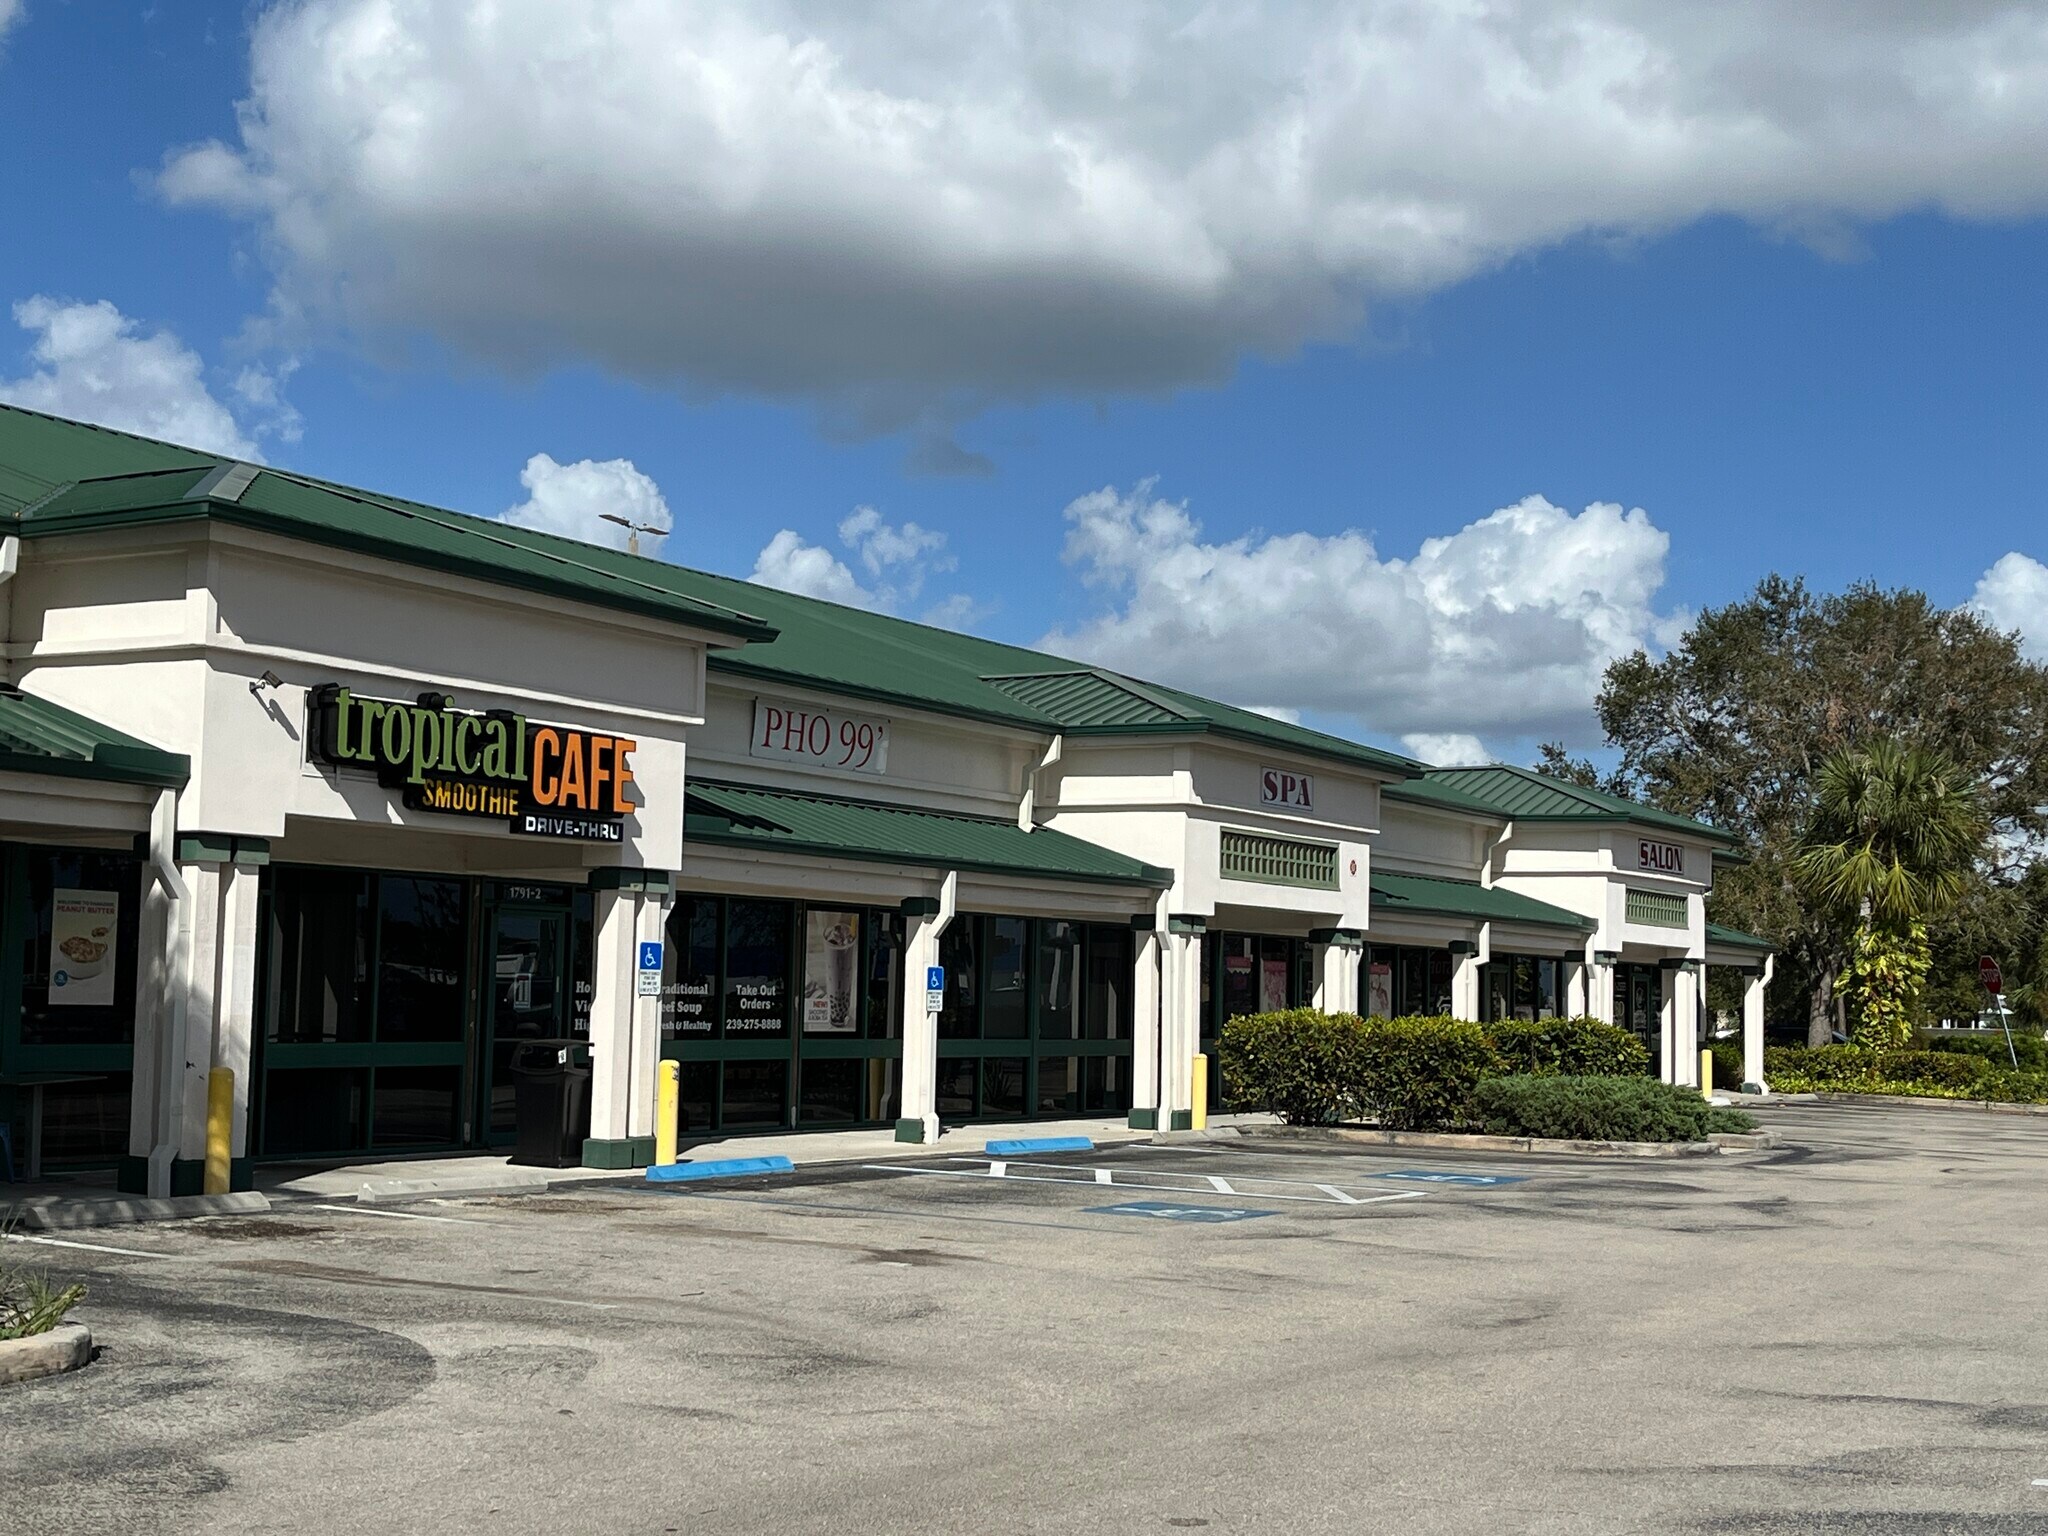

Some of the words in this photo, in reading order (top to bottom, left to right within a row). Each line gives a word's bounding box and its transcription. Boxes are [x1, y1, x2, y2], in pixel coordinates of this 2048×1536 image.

[761, 706, 830, 756] PHO
[336, 687, 528, 785] tropical
[532, 728, 637, 814] CAFE
[1263, 771, 1312, 807] SPA
[422, 778, 519, 817] SMOOTHIE
[525, 816, 620, 840] DRIVE-THRU
[1640, 842, 1683, 872] SALON
[510, 886, 541, 900] 1791-2
[56, 904, 85, 913] PEANUT
[87, 906, 115, 915] BUTTER
[1981, 968, 2000, 983] STOP
[661, 982, 709, 995] raditional
[736, 984, 758, 996] Take
[760, 984, 776, 996] Out
[677, 1001, 702, 1015] Soup
[683, 1020, 712, 1032] Healthy
[726, 1018, 782, 1030] 239-275-8888
